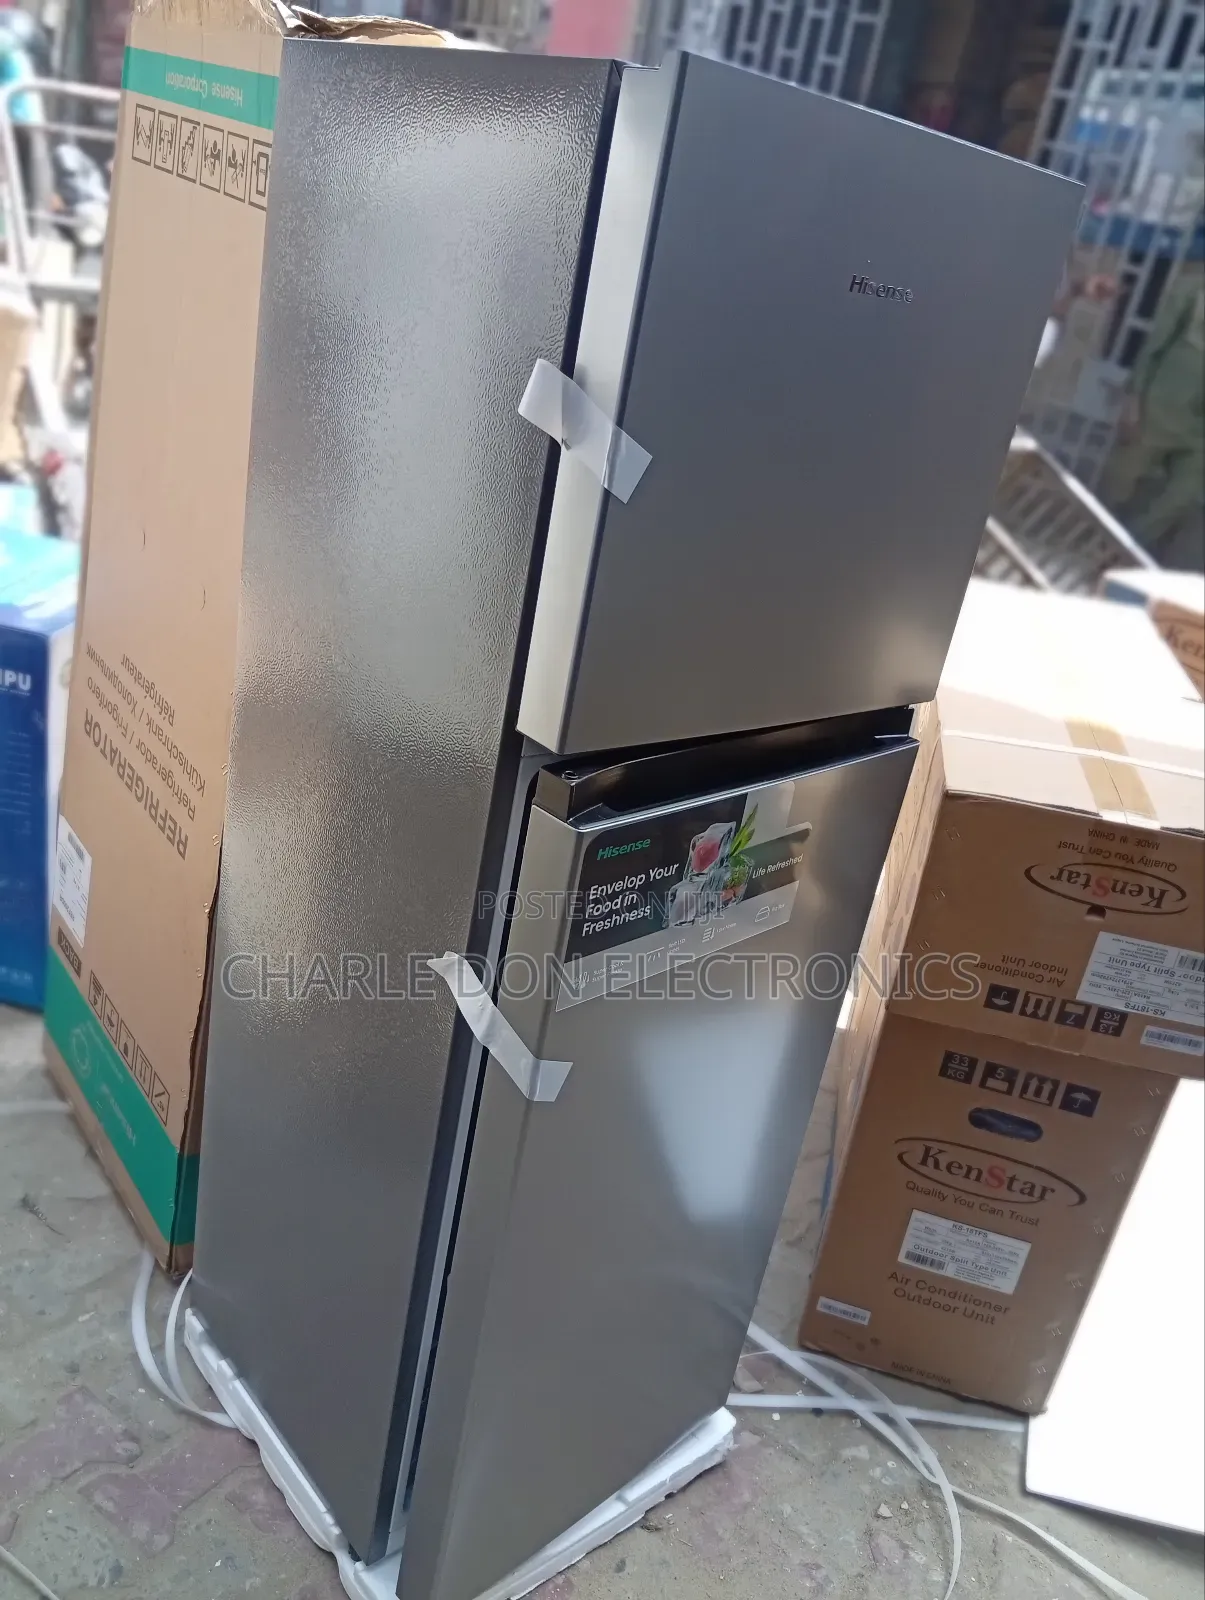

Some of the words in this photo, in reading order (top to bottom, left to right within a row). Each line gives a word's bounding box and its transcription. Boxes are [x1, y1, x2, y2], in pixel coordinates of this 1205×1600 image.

[166, 72, 207, 99] Corporation
[212, 82, 243, 108] Hisense
[849, 273, 913, 303] Hisense
[121, 653, 175, 727] Réfrigérateur
[146, 713, 206, 797] Kühlschrank
[84, 707, 188, 861] REFRIGERATOR
[135, 738, 196, 822] Refrigerador
[1088, 828, 1116, 841] CHINA
[1135, 837, 1160, 851] MADE
[597, 837, 651, 860] Hisense
[1058, 840, 1085, 854] Trust
[1089, 848, 1111, 860] Can
[1114, 852, 1136, 864] You
[752, 865, 766, 879] Life
[766, 854, 804, 874] Refreshed
[1137, 855, 1178, 873] Quality
[589, 872, 645, 900] Envelop
[649, 863, 680, 882] Your
[1050, 866, 1170, 910] KenStar
[585, 898, 620, 919] Food
[623, 892, 638, 910] in
[582, 905, 651, 937] Freshness
[974, 960, 1045, 984] Conditioner
[1001, 954, 1026, 968] Unit
[1031, 959, 1068, 977] Indoor
[1108, 956, 1127, 966] Unit
[1050, 976, 1066, 987] Air
[1100, 1023, 1115, 1034] 13
[1103, 1012, 1120, 1021] KG
[950, 1053, 969, 1068] 33
[947, 1068, 966, 1080] KG
[995, 1067, 1005, 1079] 5
[917, 1142, 1056, 1202] KenStar
[905, 1180, 948, 1203] Quality
[952, 1193, 976, 1209] You
[979, 1202, 1004, 1218] Can
[1009, 1210, 1041, 1227] Trust
[913, 1244, 948, 1259] Outdoor
[950, 1255, 969, 1266] Split
[990, 1268, 1008, 1277] Unit
[888, 1271, 912, 1288] Air
[915, 1279, 1011, 1315] Conditioner
[894, 1287, 960, 1315] Outdoor
[964, 1308, 997, 1326] Unit
